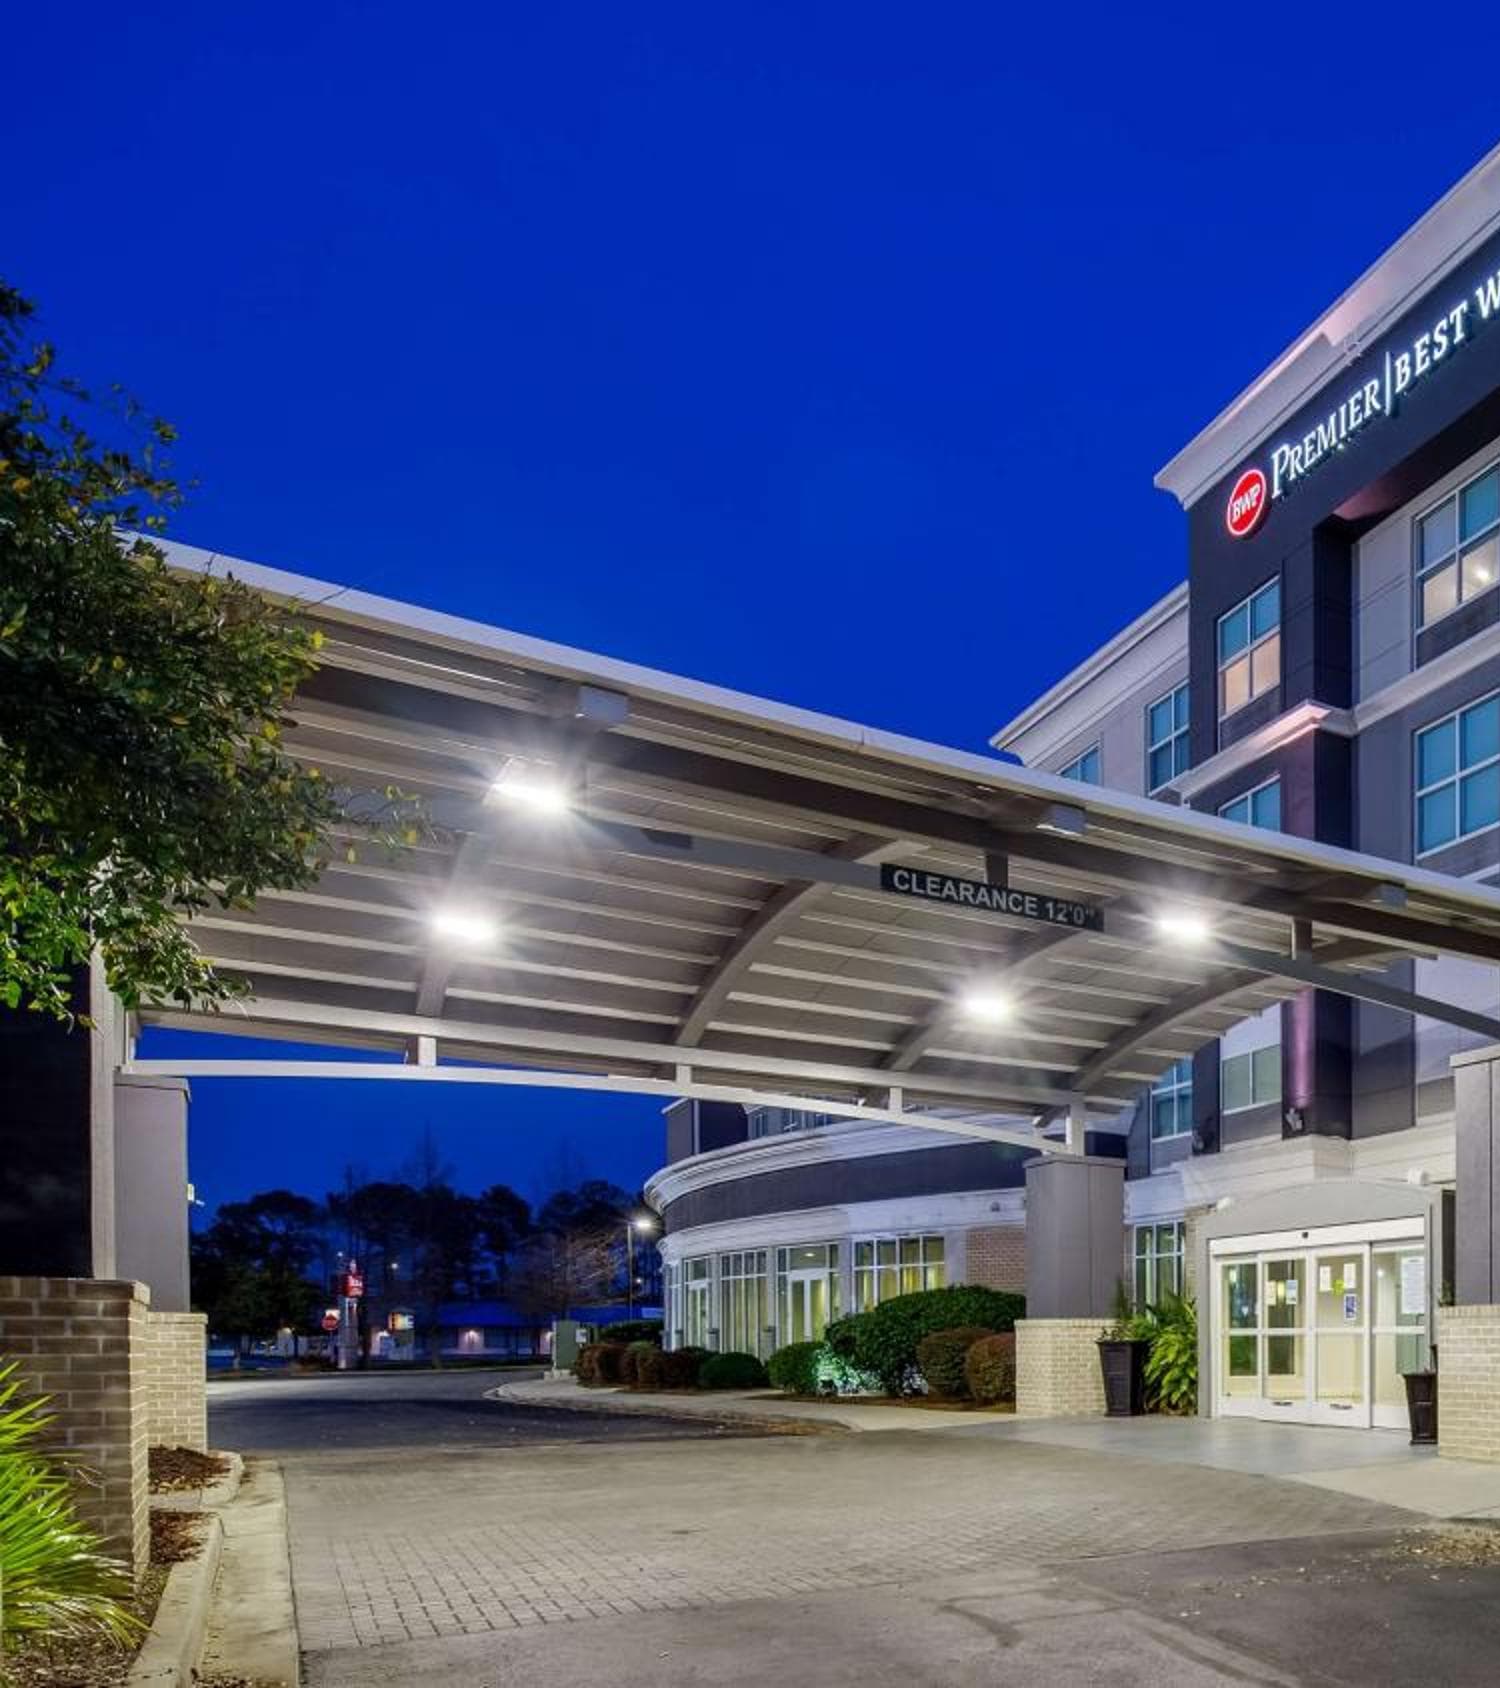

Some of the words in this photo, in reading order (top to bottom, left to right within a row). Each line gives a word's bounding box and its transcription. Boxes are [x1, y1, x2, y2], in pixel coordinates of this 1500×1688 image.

[1271, 382, 1381, 498] PREMIER
[1394, 301, 1469, 394] BEST
[1232, 483, 1260, 523] BWP
[893, 869, 1038, 917] CLEARANCE
